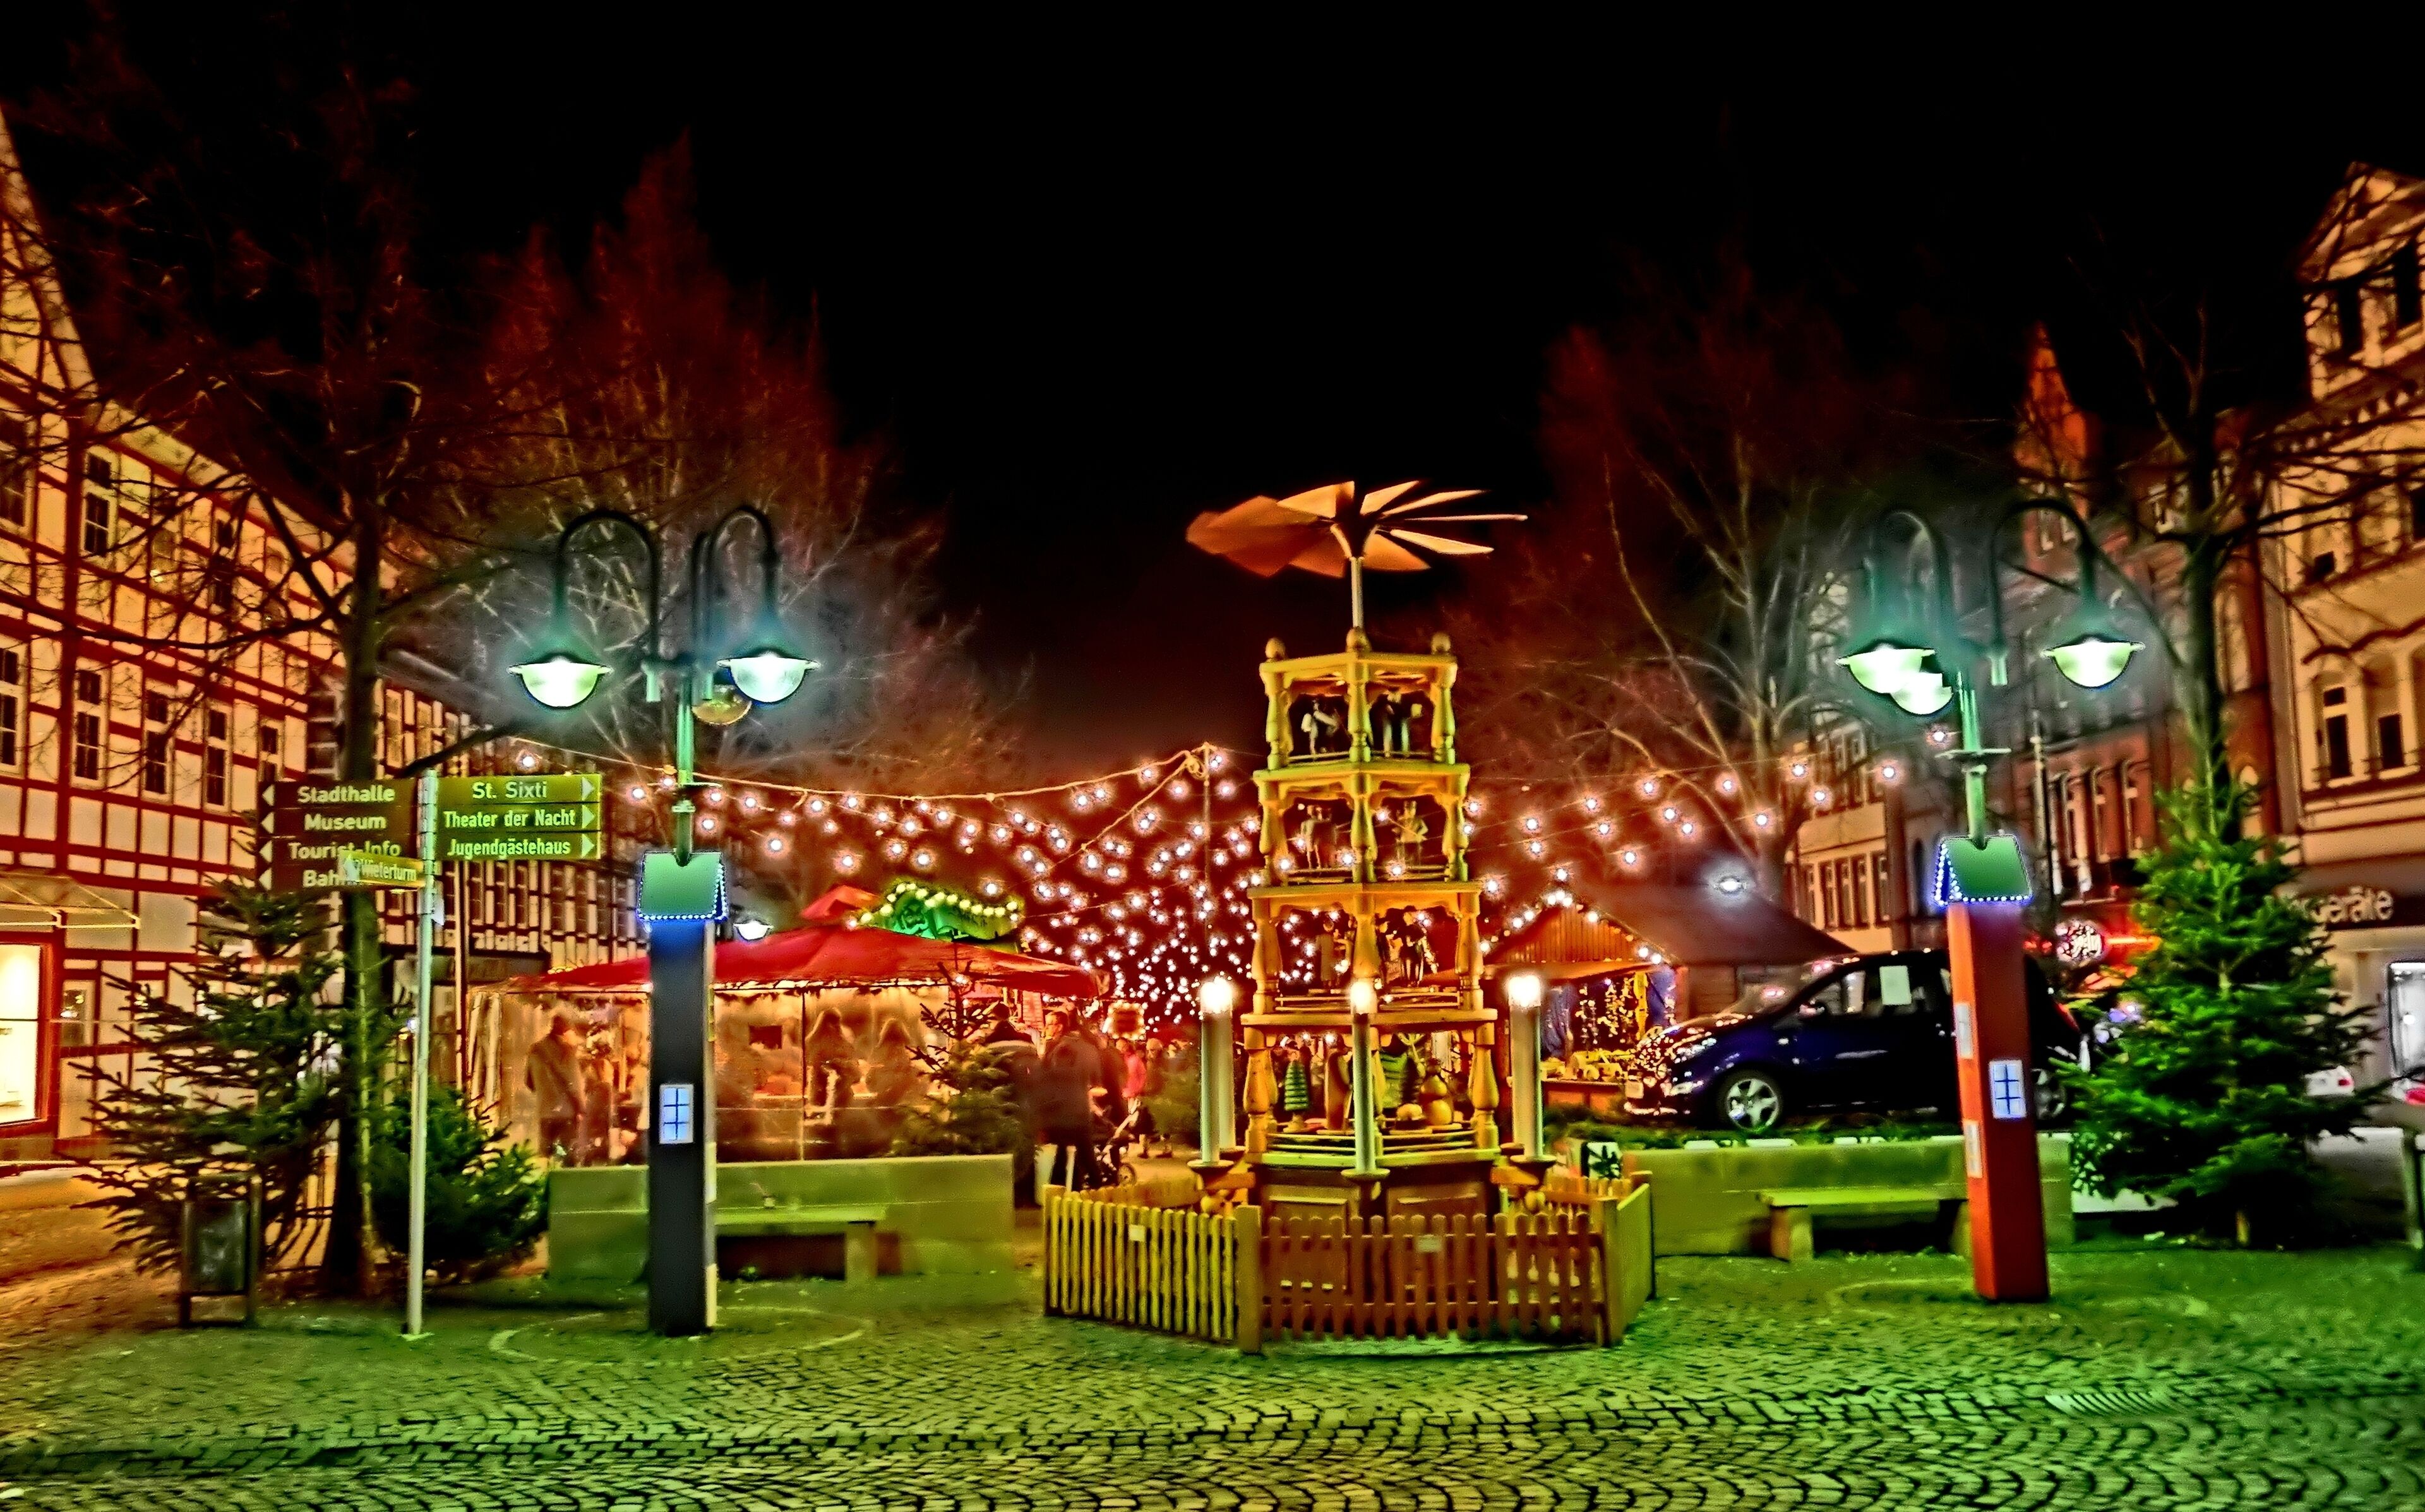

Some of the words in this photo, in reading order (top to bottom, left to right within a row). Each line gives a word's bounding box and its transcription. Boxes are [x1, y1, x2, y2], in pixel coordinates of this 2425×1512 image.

[297, 785, 395, 803] Stadthalle
[472, 782, 497, 799] St.
[505, 781, 548, 799] Sixti
[304, 813, 386, 830] Museum
[443, 811, 498, 828] Theater
[504, 810, 529, 827] der
[534, 809, 576, 826] Nacht
[288, 840, 402, 859] Tourist-Info
[447, 837, 571, 860] Jugendgästehaus
